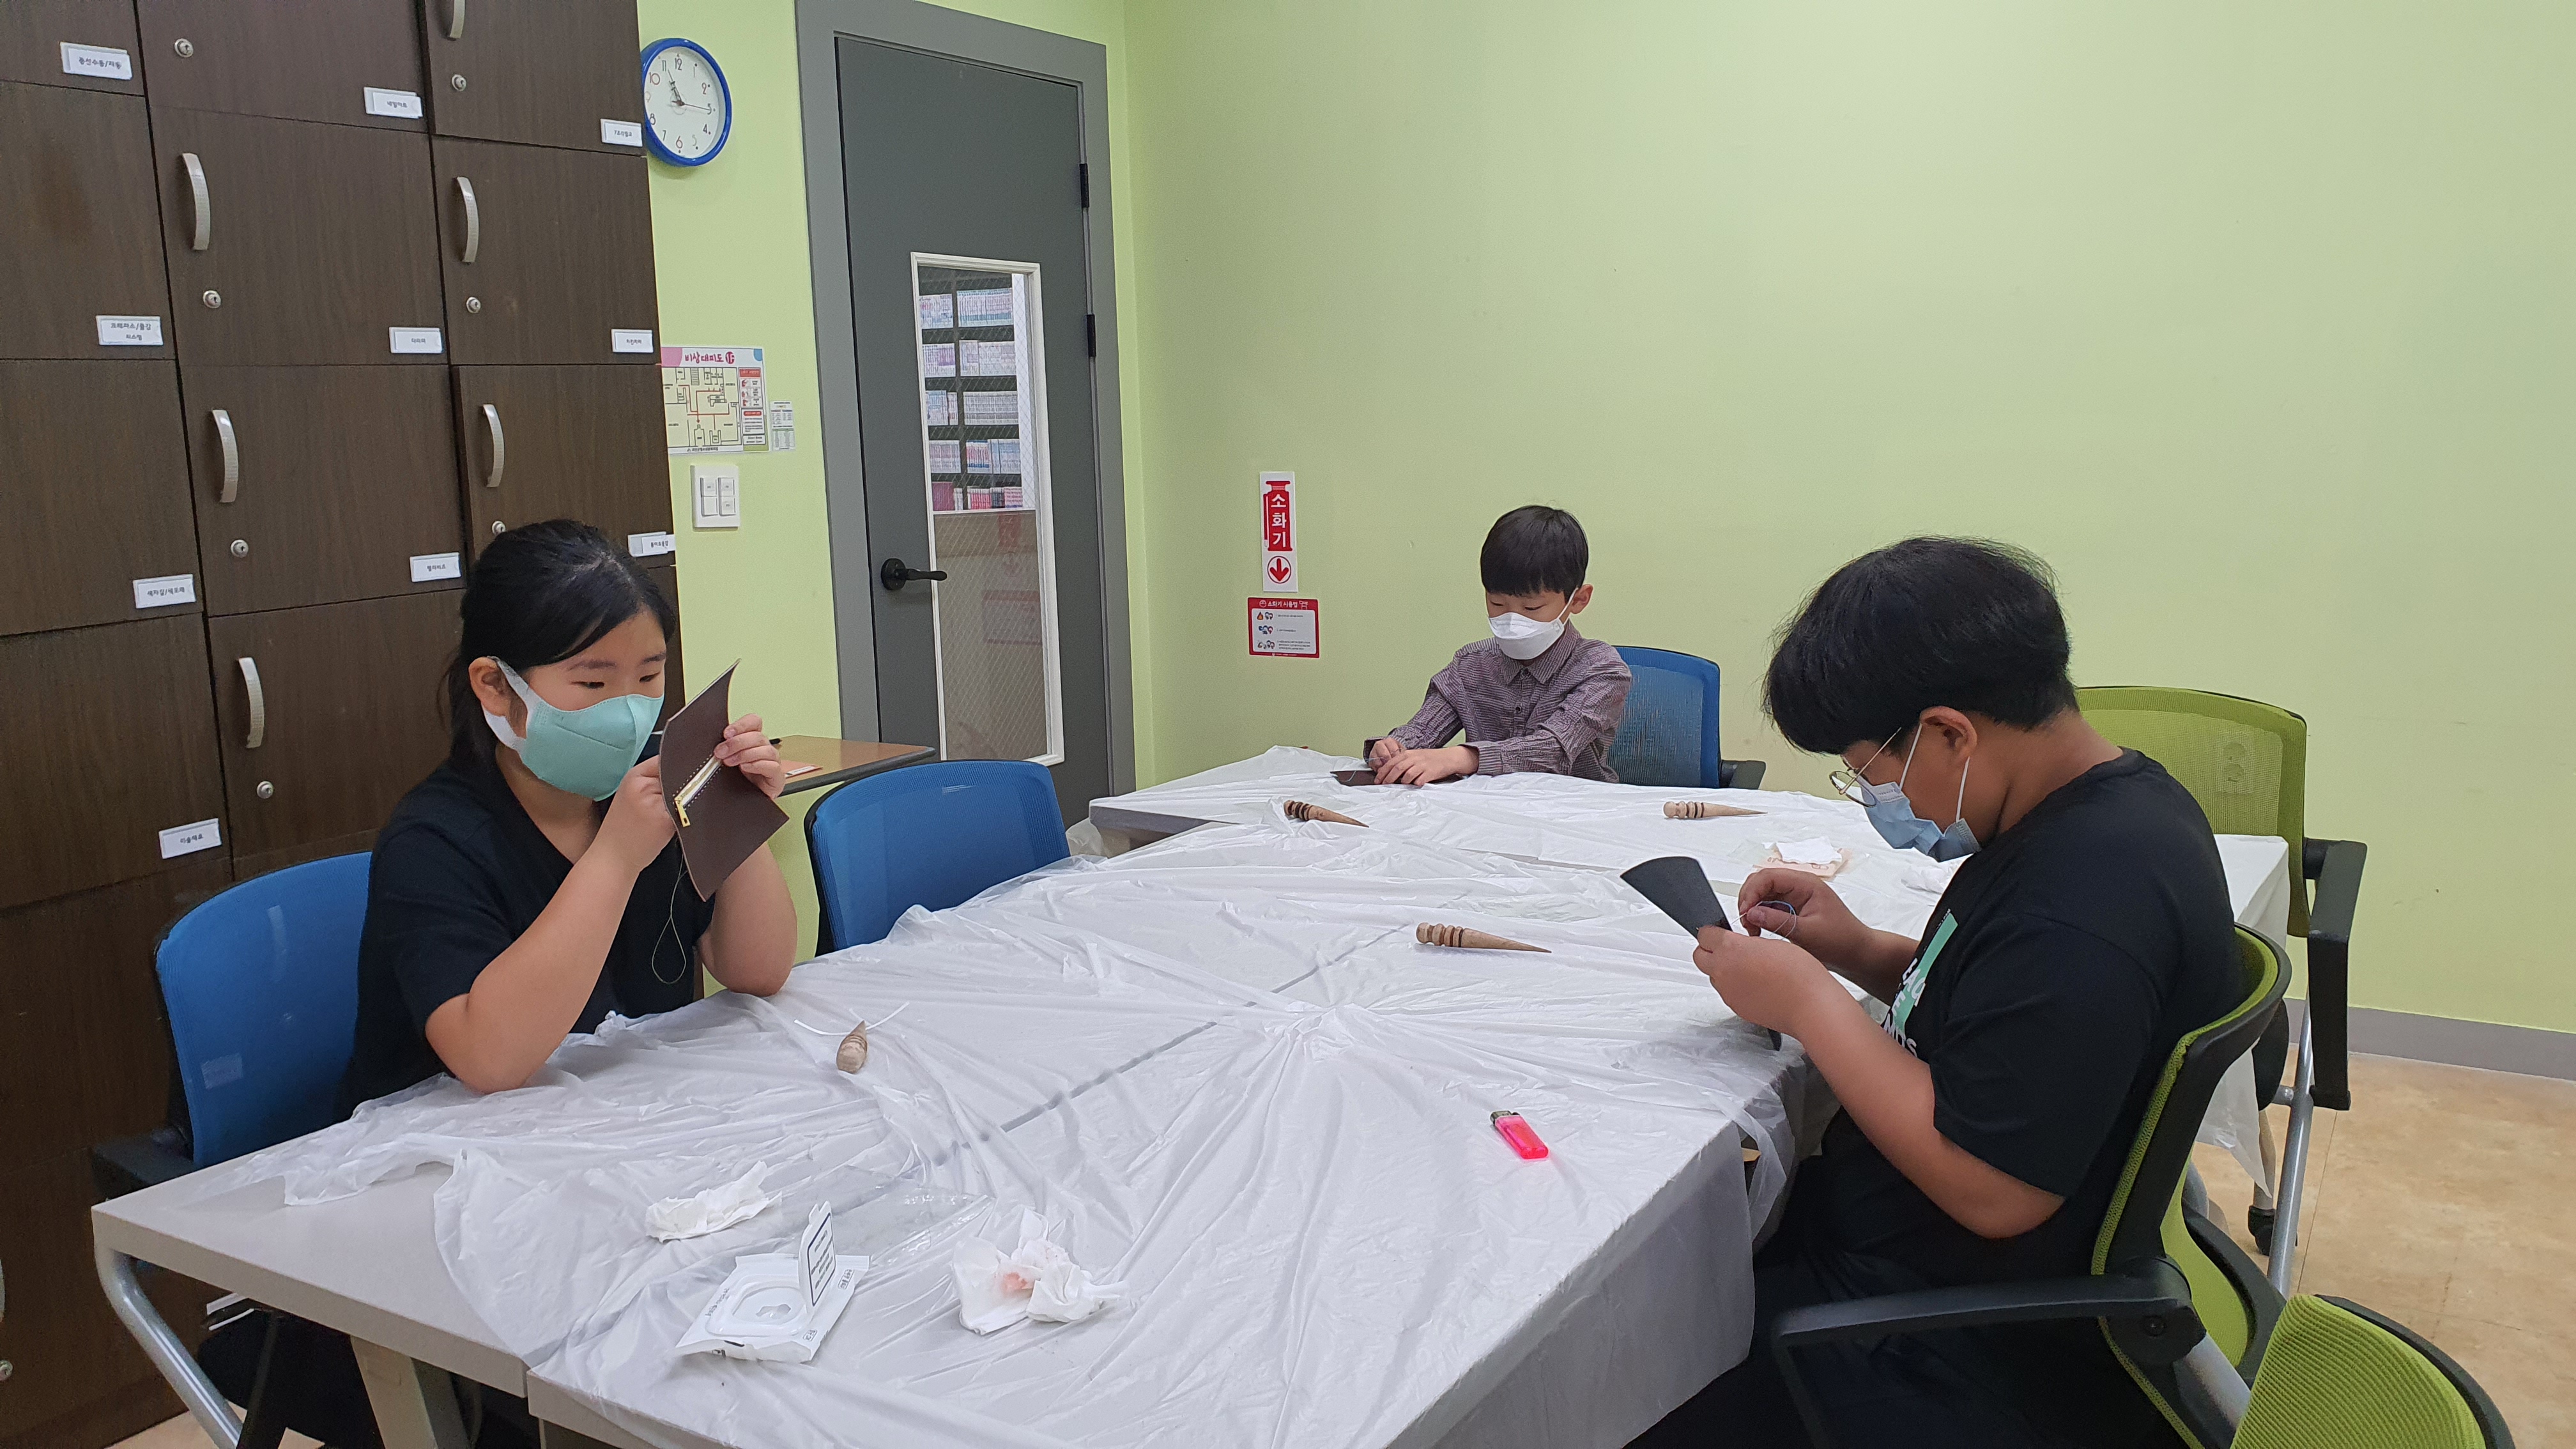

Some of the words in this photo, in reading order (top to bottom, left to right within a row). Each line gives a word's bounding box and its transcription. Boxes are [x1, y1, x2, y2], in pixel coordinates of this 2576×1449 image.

[662, 60, 667, 72] 11
[675, 58, 683, 71] 12
[649, 72, 661, 86] 10
[702, 82, 707, 95] 2
[707, 103, 712, 115] 3
[649, 113, 656, 126] 8
[703, 123, 708, 134] 4
[663, 130, 667, 141] 7
[675, 135, 683, 149] 6
[692, 134, 698, 147] 5
[685, 351, 724, 364] 비상대피도
[1270, 493, 1287, 548] 소화기
